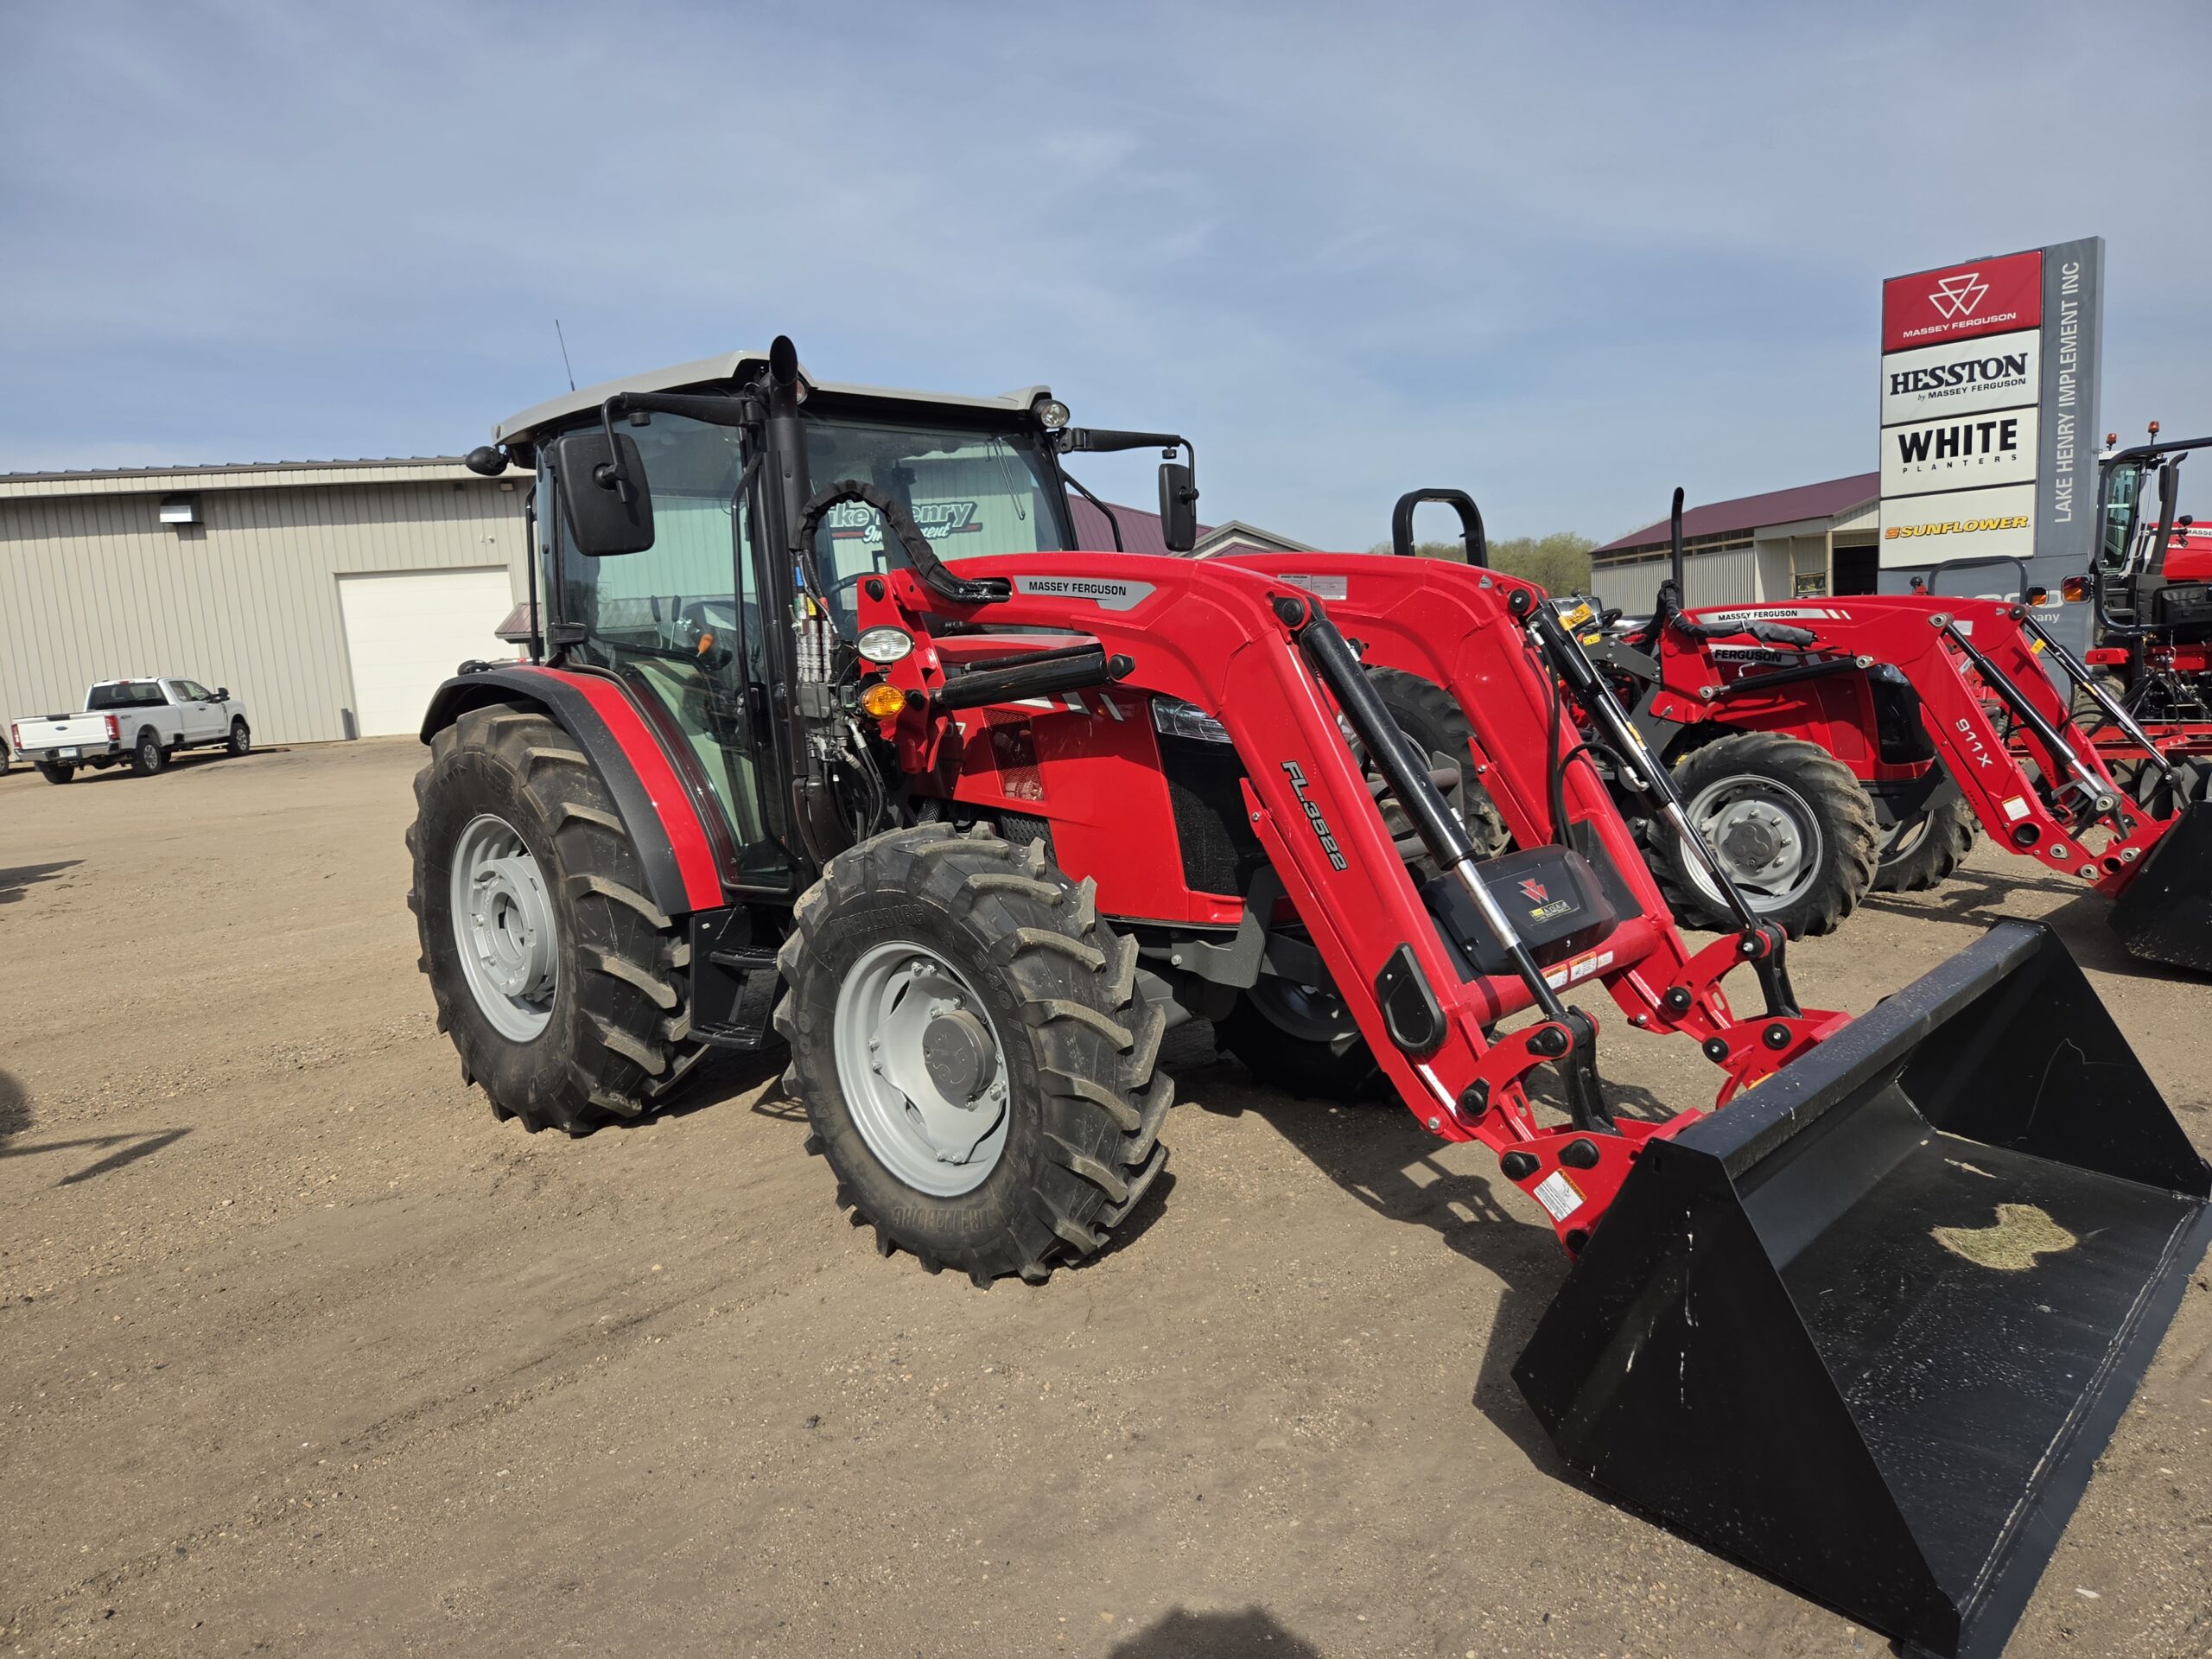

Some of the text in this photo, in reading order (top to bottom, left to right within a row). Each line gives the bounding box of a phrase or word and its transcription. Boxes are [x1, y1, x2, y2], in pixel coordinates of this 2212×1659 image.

[1903, 312, 2017, 338] MASSEY FERGUSON
[1890, 353, 2028, 396] HESSTON
[1928, 386, 1967, 399] MASSEY
[1971, 378, 2026, 392] FERGUSON
[2054, 261, 2079, 523] LAKE HENRY IMPLEMENT INC
[1898, 418, 2018, 464] WHITE
[1903, 454, 2017, 474] PLANTERS
[1900, 516, 2029, 537] SUNFLOWER
[1029, 582, 1127, 596] MASSEY FERGUSON
[1718, 610, 1798, 621] MASSEY FERGUSON
[1714, 649, 1783, 663] FERGUSON
[1955, 718, 1993, 768] 911X
